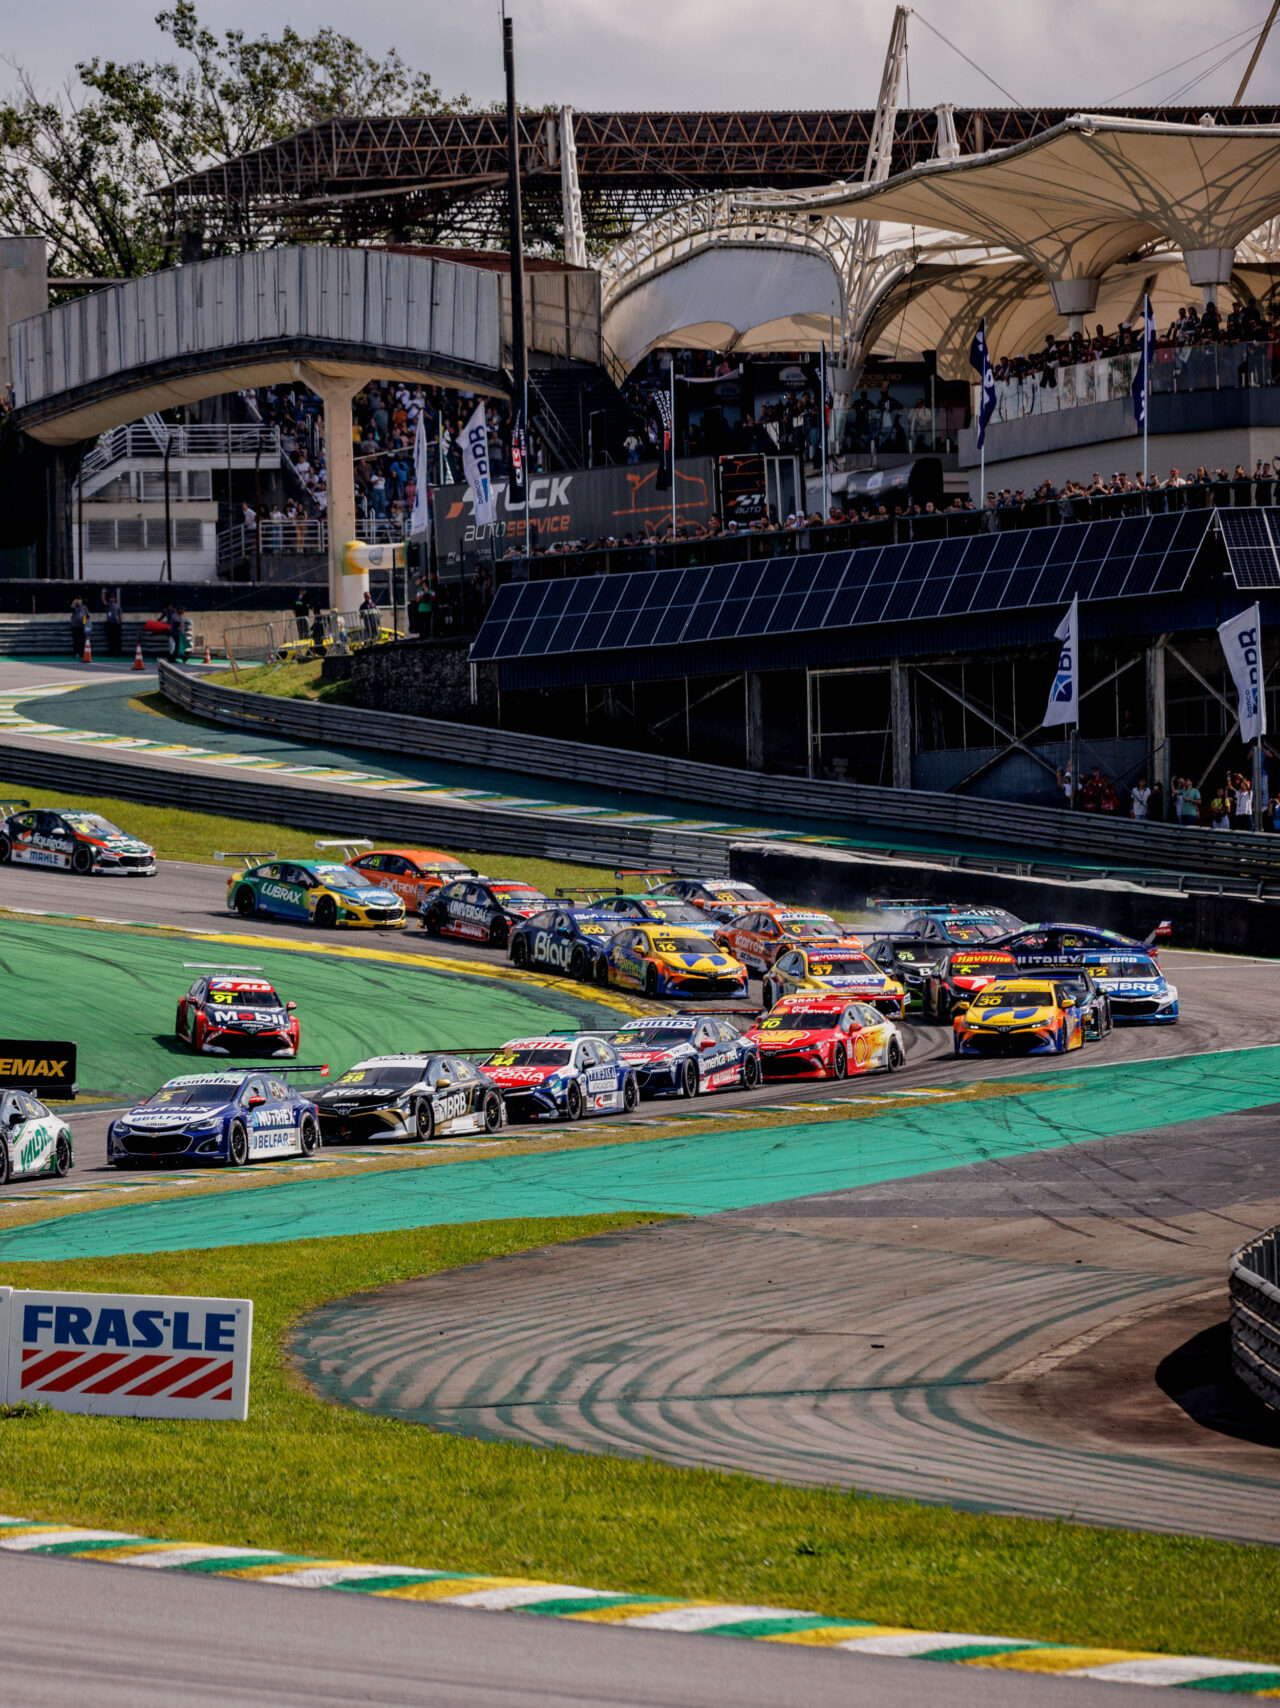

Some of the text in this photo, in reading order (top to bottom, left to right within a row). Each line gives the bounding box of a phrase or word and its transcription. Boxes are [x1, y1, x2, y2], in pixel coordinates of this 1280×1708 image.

[30, 850, 59, 864] MAHLE
[380, 878, 418, 894] EXTRON
[260, 882, 303, 905] LUBRAX
[450, 900, 487, 919] UNIVERSAL
[581, 926, 605, 934] 300
[792, 926, 802, 934] 6
[659, 944, 676, 952] 16
[898, 952, 915, 961] 95
[812, 964, 832, 975] 37
[1088, 968, 1108, 976] 12
[1118, 982, 1159, 992] BRB
[214, 994, 232, 1004] 91
[978, 998, 1002, 1006] 30
[214, 1010, 284, 1024] Mobil
[626, 1020, 694, 1028] PHILIPS
[761, 1020, 781, 1028] 10
[489, 1057, 515, 1066] 44
[339, 1074, 365, 1084] 28
[345, 1088, 395, 1096] BRB
[158, 1094, 174, 1102] 5
[448, 1092, 467, 1117] BRB
[132, 1106, 213, 1114] NUTRIEX
[259, 1108, 295, 1126] NUTRIEX
[259, 1132, 289, 1148] BELFAR
[21, 1124, 53, 1172] VALDA
